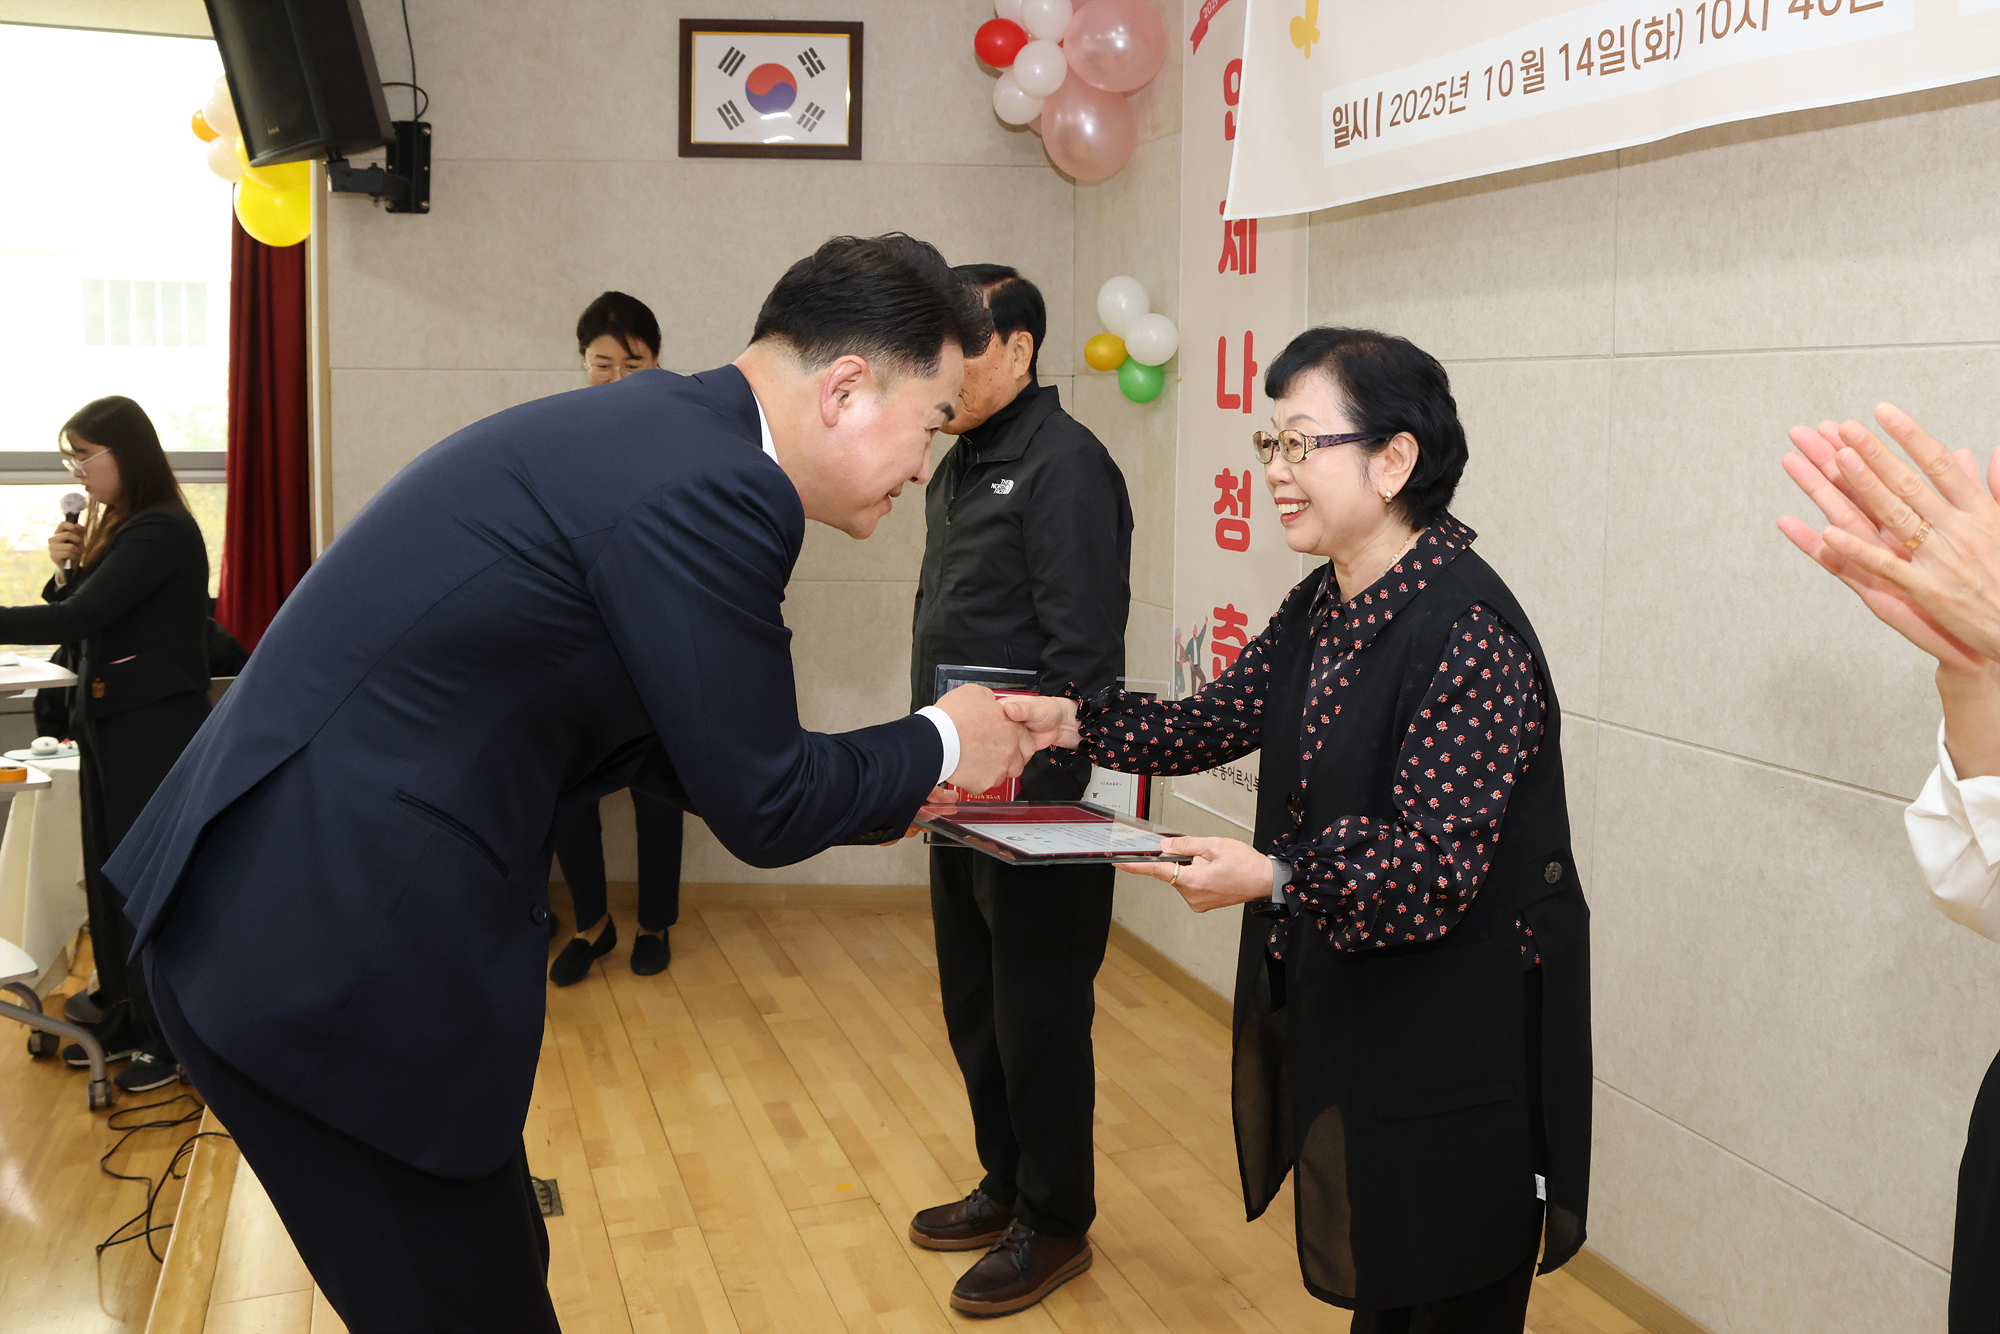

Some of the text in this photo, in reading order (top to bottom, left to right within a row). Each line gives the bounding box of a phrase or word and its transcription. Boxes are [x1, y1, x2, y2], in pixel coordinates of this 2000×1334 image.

[1332, 0, 1770, 150] 일시 2025년 10월 14일(화) 10시
